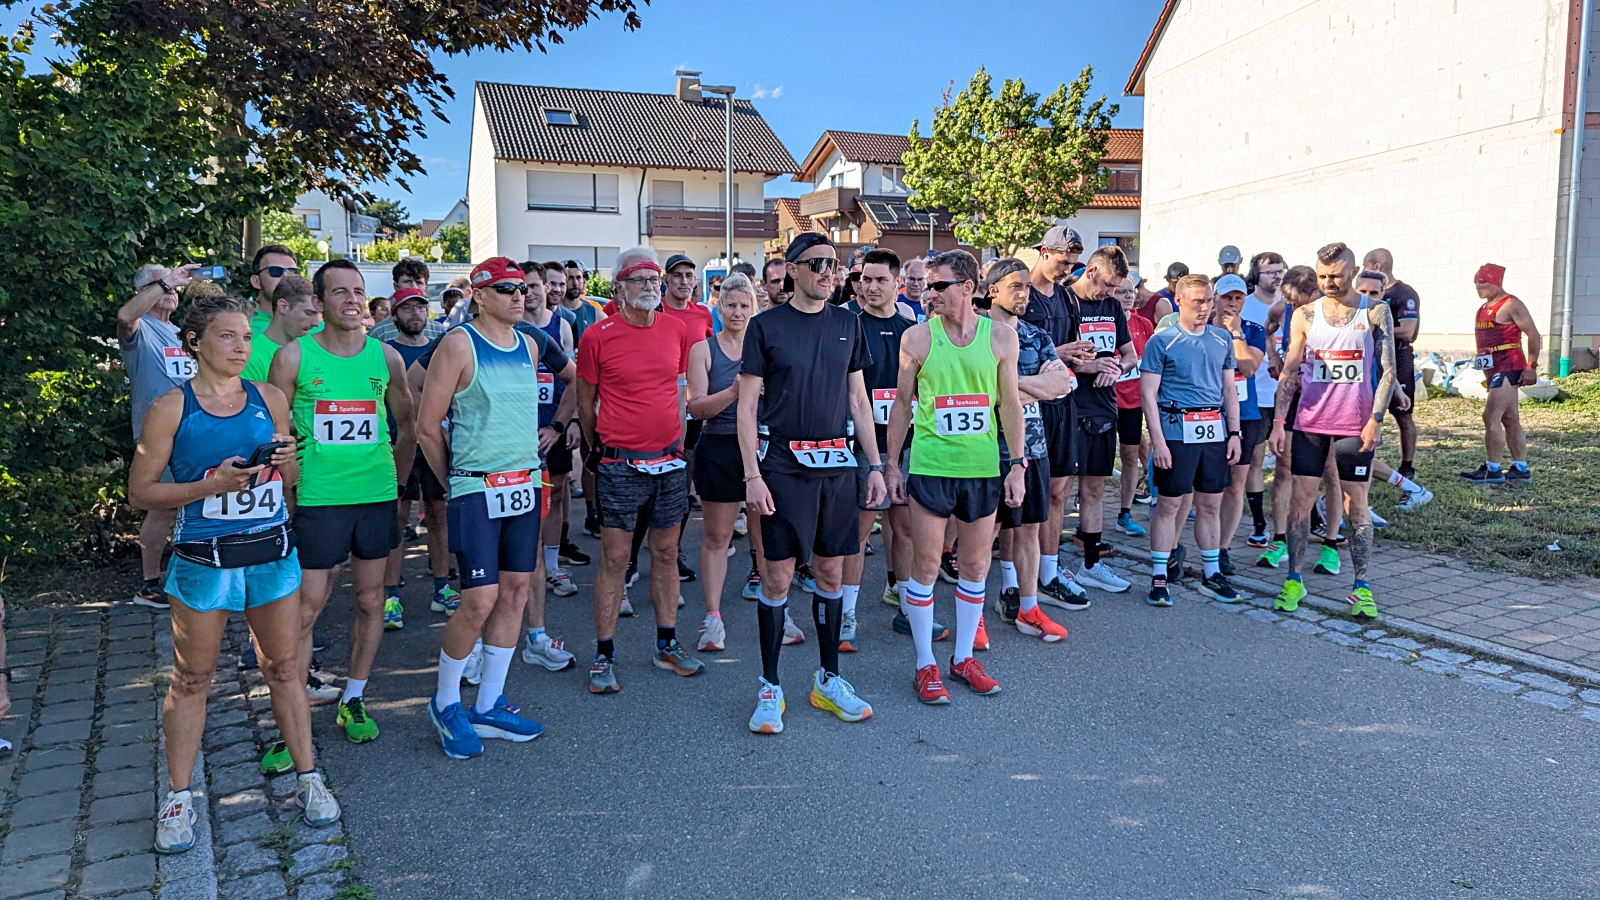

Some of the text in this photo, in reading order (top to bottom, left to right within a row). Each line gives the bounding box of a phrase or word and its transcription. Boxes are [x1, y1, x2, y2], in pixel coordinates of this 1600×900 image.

[1320, 364, 1358, 380] 150
[323, 419, 373, 441] 124
[943, 412, 985, 431] 135
[1194, 424, 1215, 440] 98
[803, 450, 849, 465] 173
[215, 487, 277, 516] 194
[495, 488, 531, 513] 183
